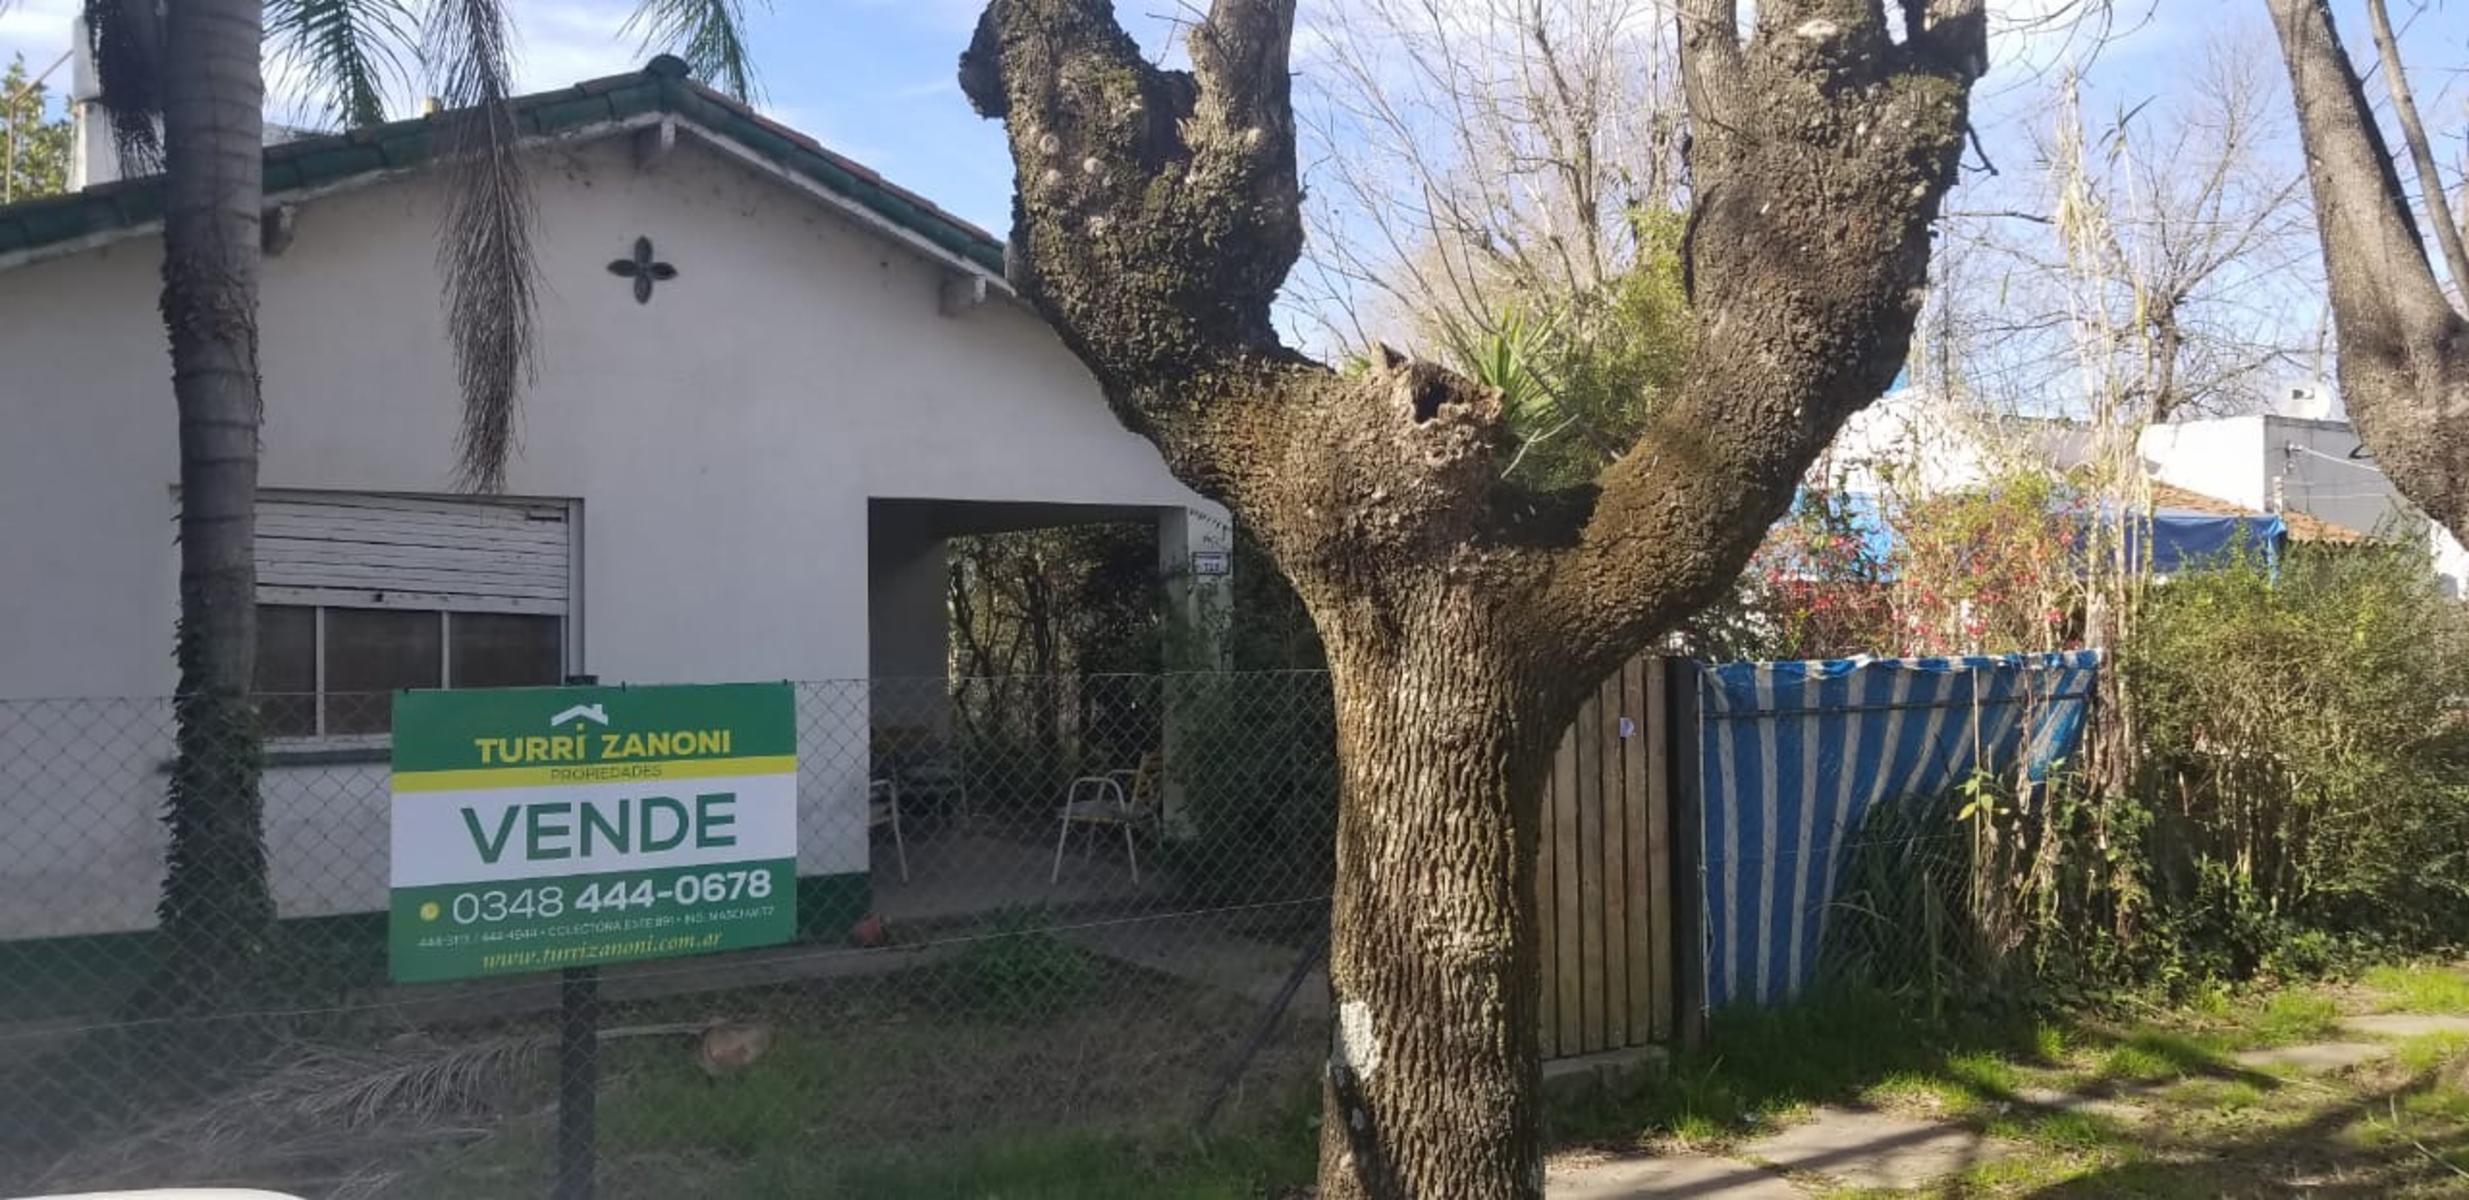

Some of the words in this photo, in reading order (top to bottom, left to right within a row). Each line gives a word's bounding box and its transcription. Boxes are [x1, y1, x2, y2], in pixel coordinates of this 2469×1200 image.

[601, 729, 732, 759] ZANONI
[550, 764, 662, 781] PROPIEDADES
[460, 792, 737, 864] VENDE
[452, 886, 564, 924] 0348
[575, 868, 772, 914] 444-0678
[547, 918, 622, 937] COLECTORA
[482, 932, 723, 969] www.turrizanoni.com.ar
